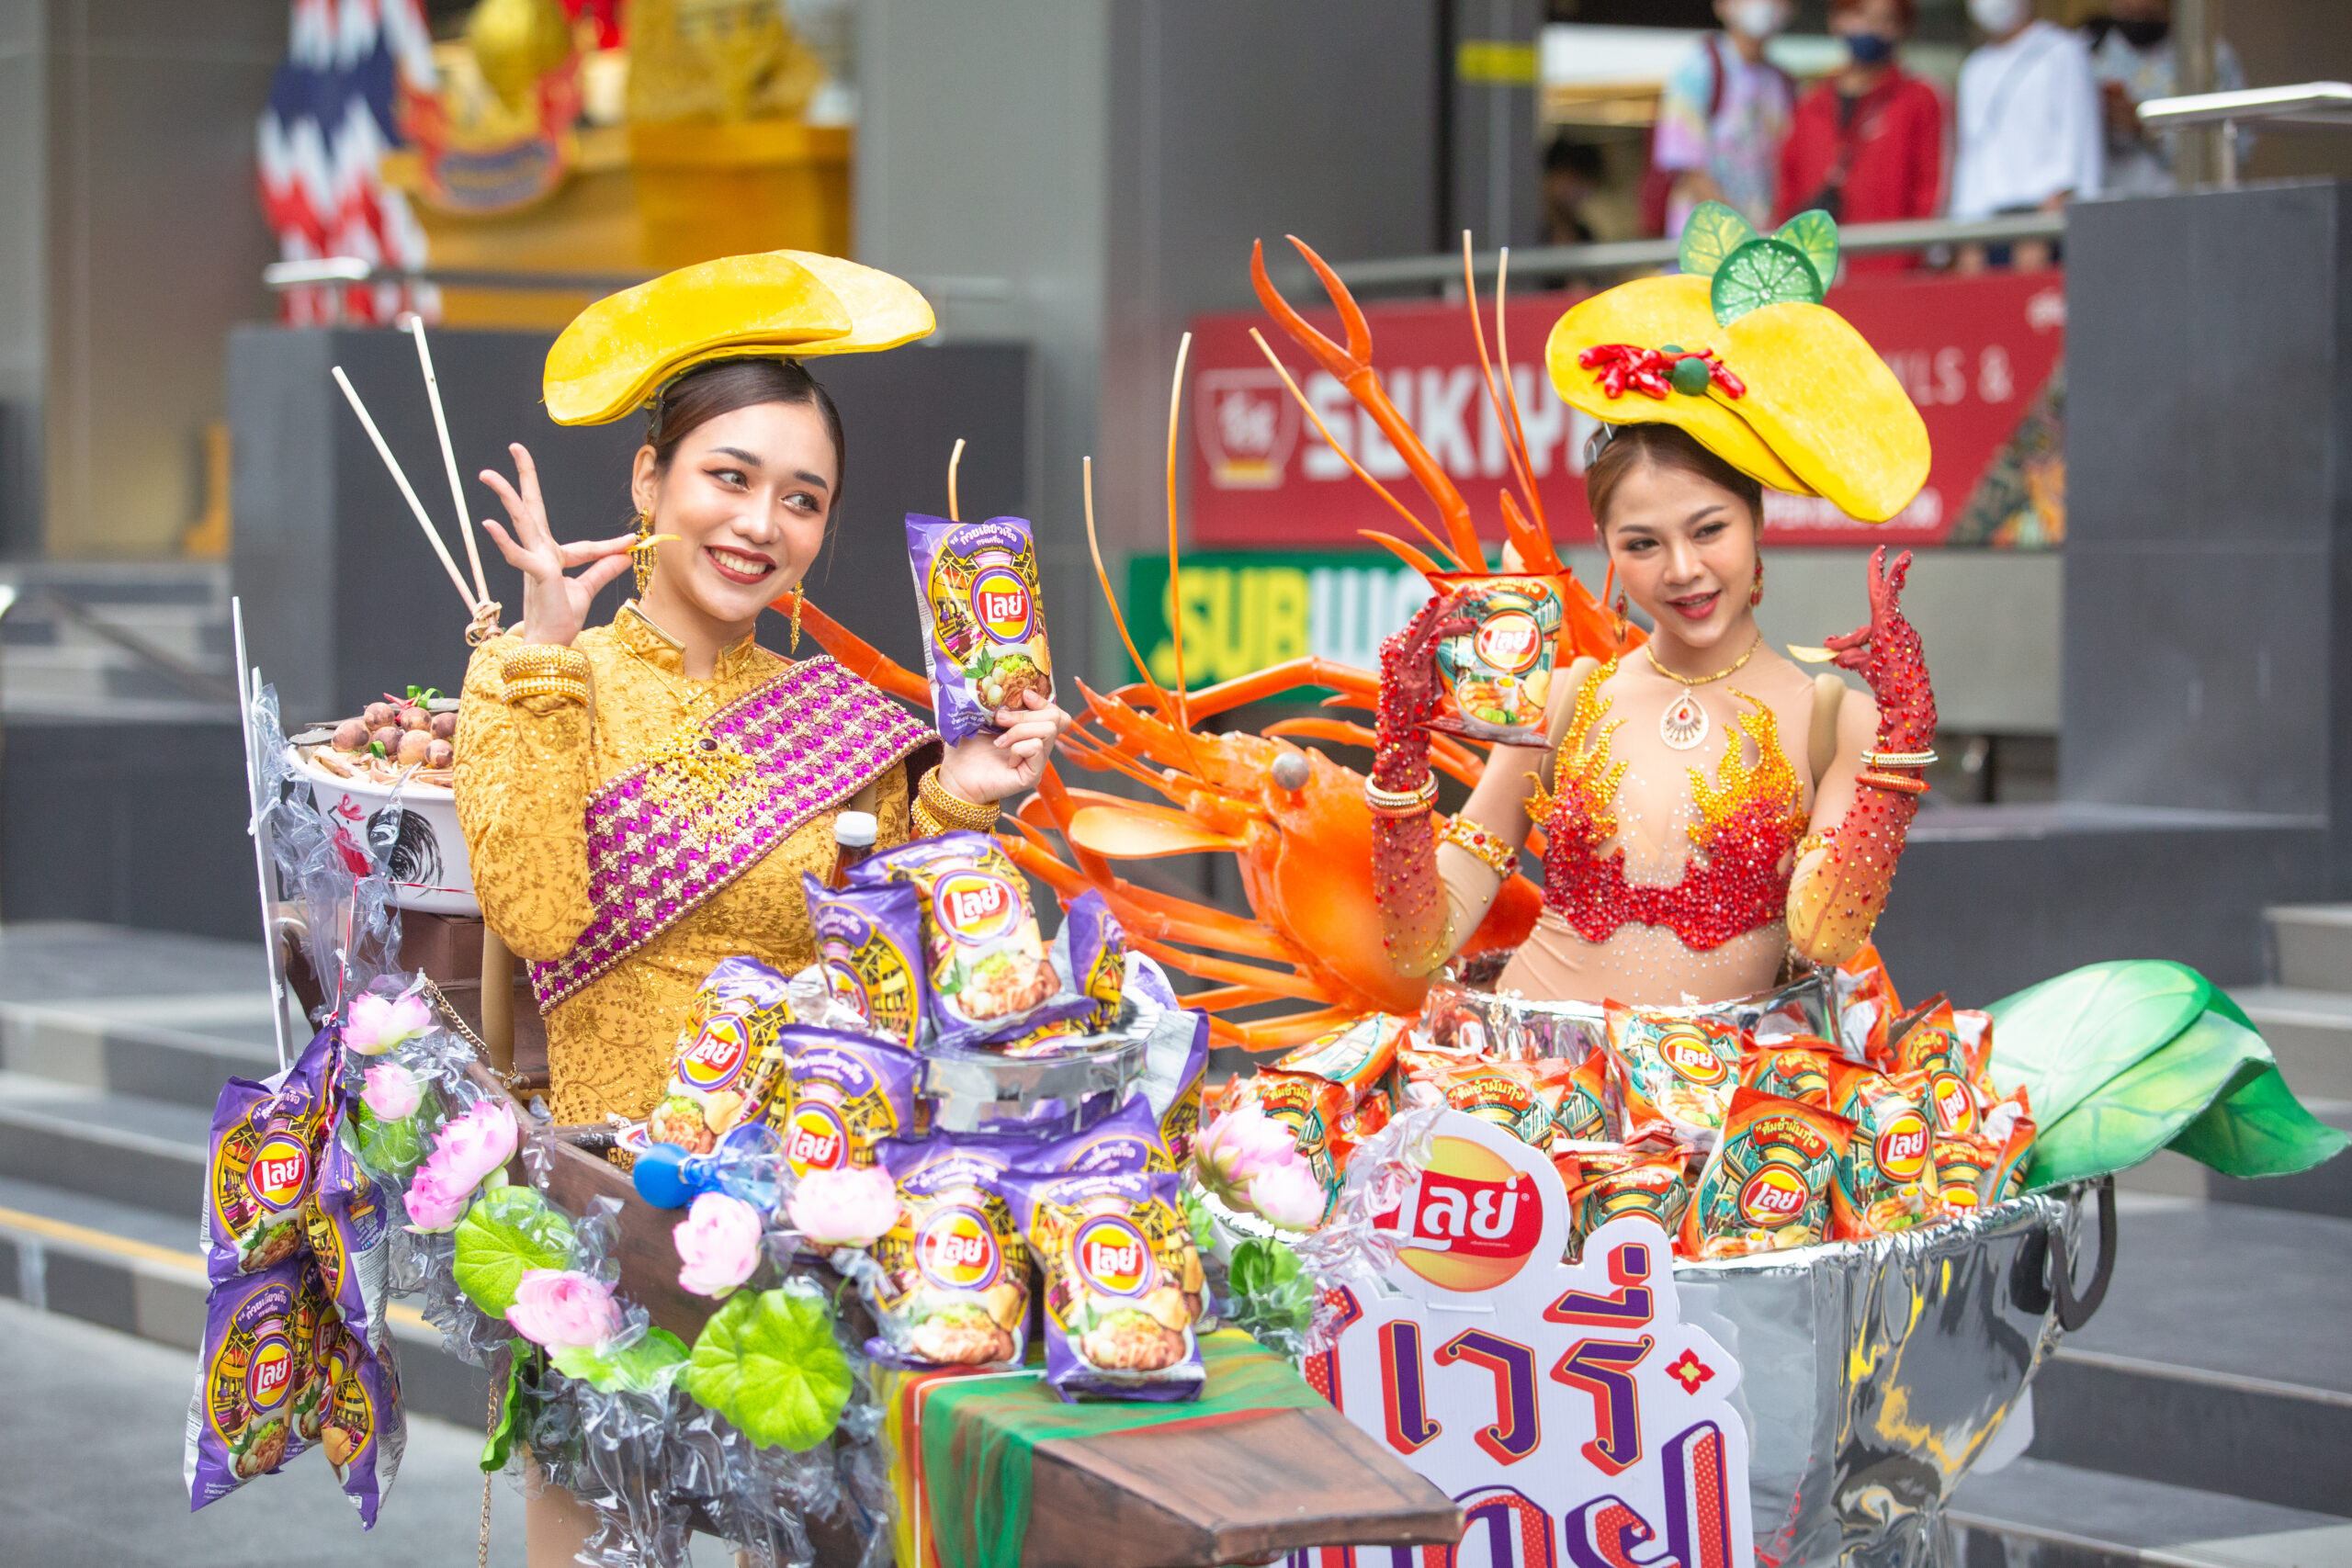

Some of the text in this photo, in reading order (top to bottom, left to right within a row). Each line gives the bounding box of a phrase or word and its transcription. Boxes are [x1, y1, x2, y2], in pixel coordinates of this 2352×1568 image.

[1302, 364, 1588, 480] SUKIY
[985, 589, 1023, 623] เลย์
[951, 876, 1001, 929] เลย์
[687, 1032, 738, 1065] เลย์
[1674, 1045, 1715, 1066] เลย์
[788, 1125, 836, 1164] เลย์
[1886, 1127, 1925, 1163] เลย์
[262, 1153, 300, 1193] เลย์
[1395, 1172, 1519, 1252] เลย์
[1750, 1182, 1800, 1212] เลย์
[933, 1231, 983, 1268] เลย์
[1091, 1241, 1137, 1278] เลย์
[257, 1353, 288, 1395] เลย์
[1378, 1243, 1657, 1477] เวรี่
